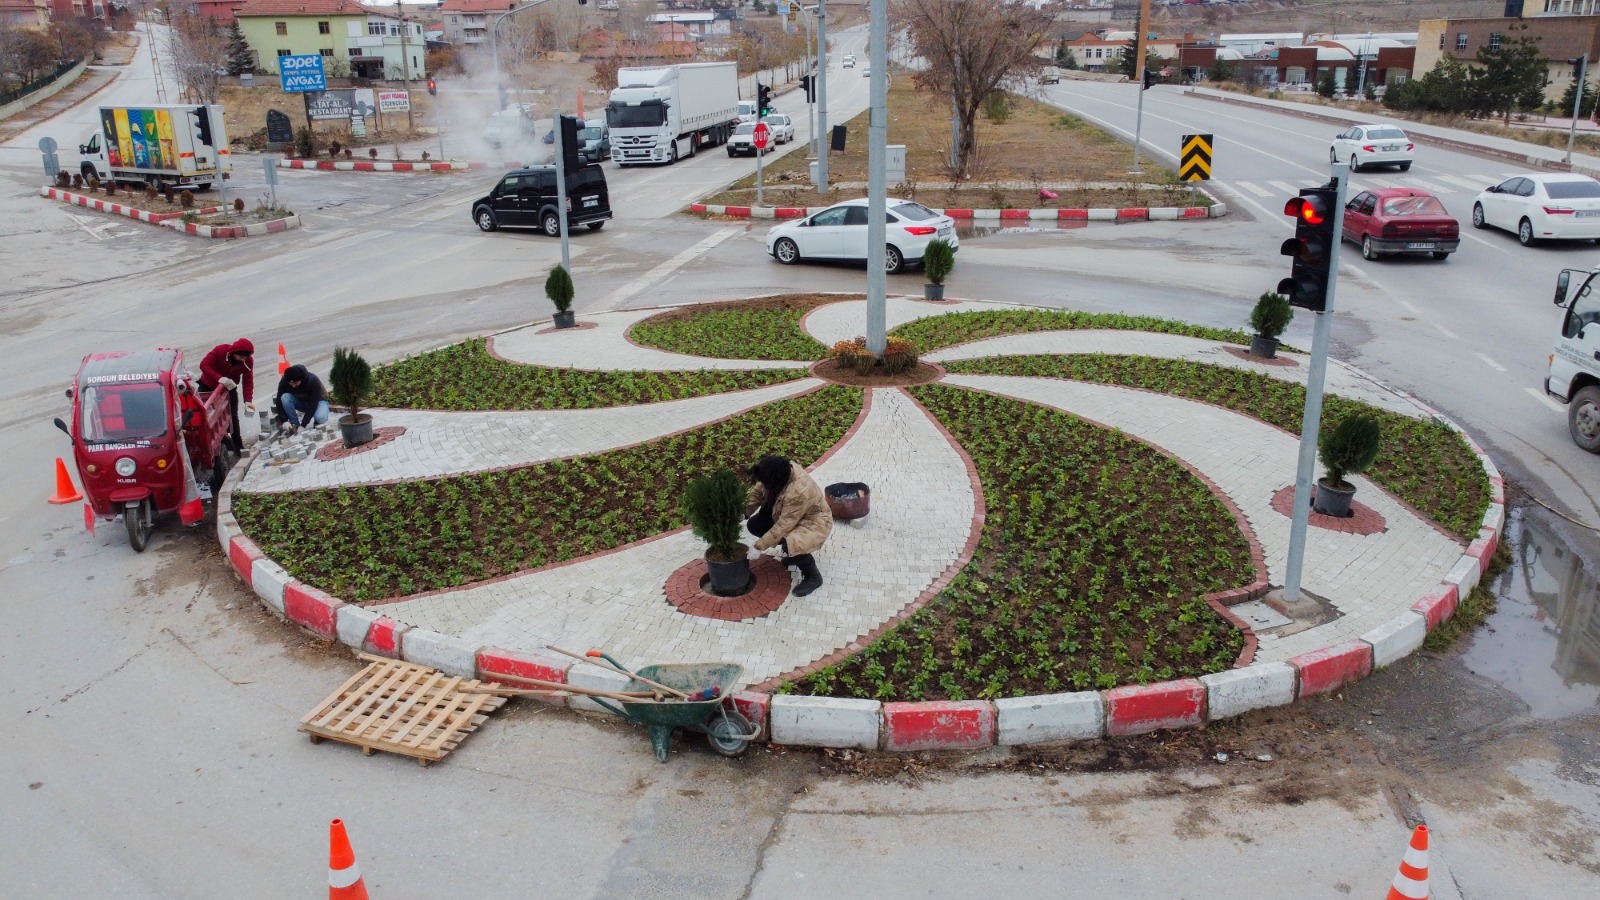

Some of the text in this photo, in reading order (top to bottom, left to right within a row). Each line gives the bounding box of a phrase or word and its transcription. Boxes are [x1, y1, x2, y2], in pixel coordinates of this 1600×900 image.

[286, 75, 323, 86] AYGAZ
[317, 100, 343, 108] TAT-AL
[308, 107, 352, 116] RESTAURANT
[87, 375, 117, 384] SORGUN
[87, 444, 104, 453] PARK
